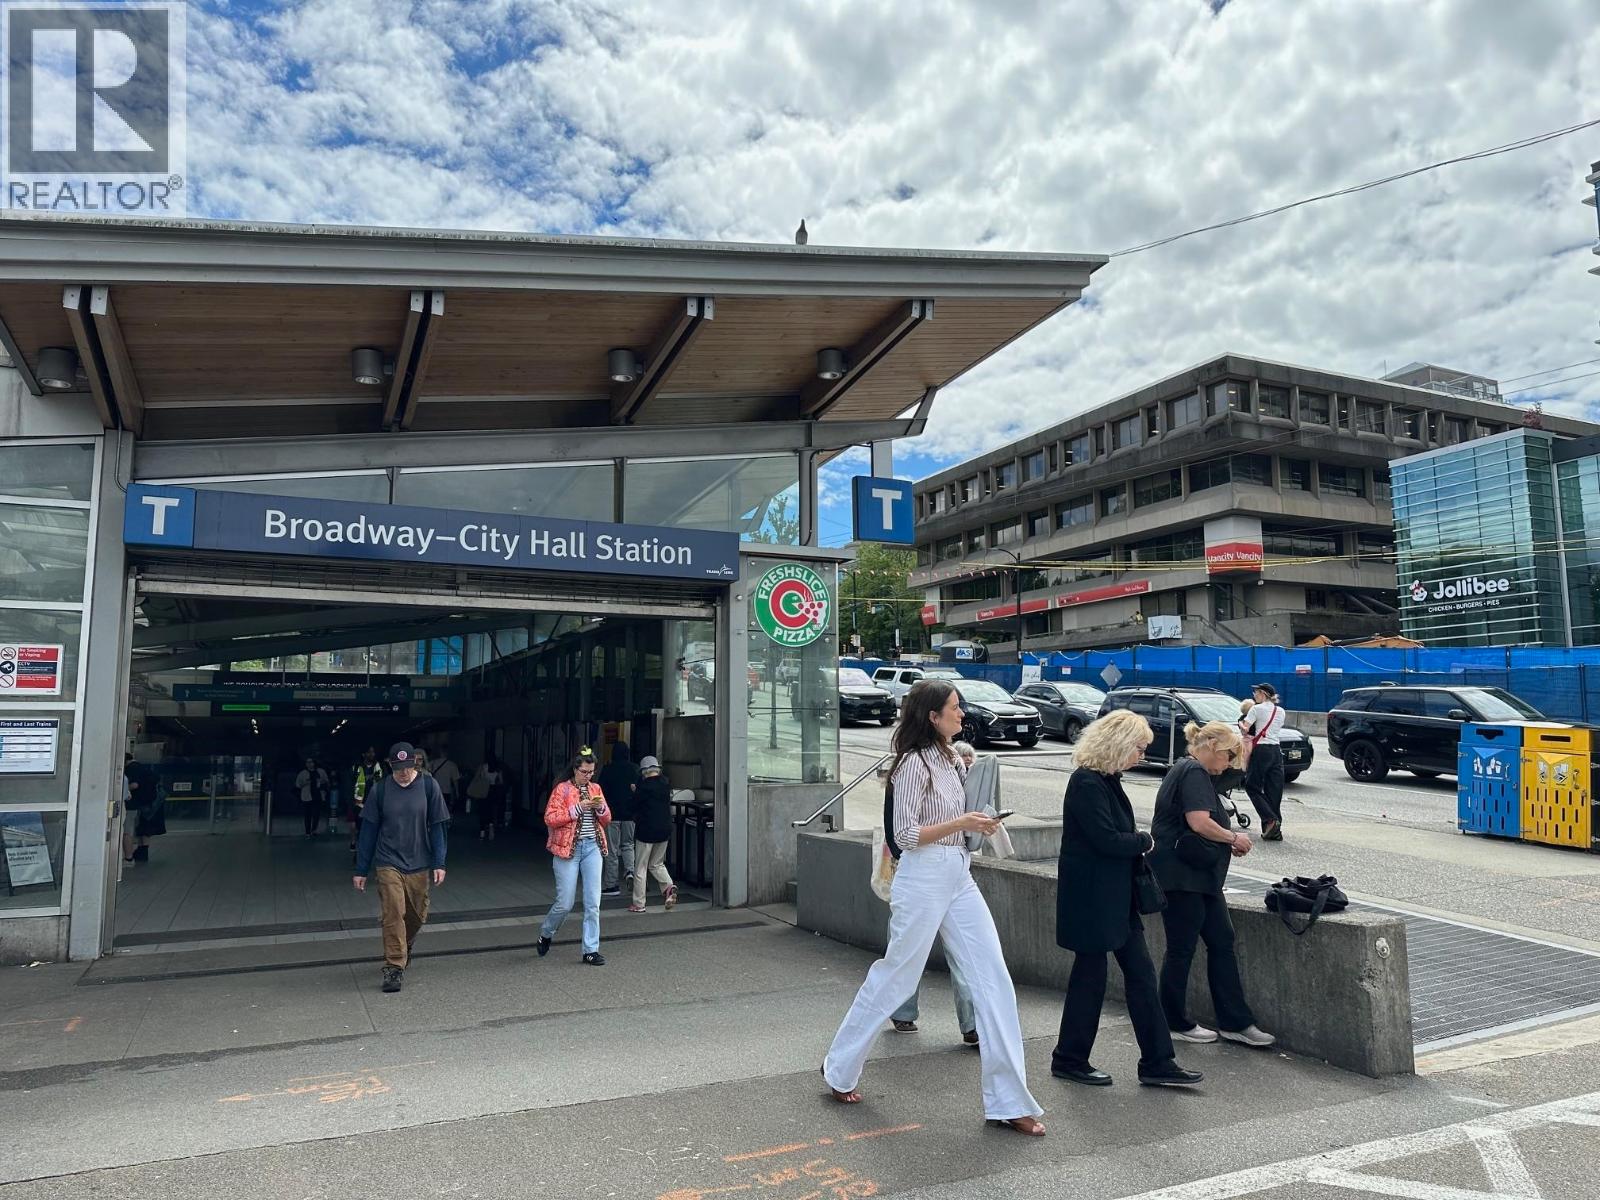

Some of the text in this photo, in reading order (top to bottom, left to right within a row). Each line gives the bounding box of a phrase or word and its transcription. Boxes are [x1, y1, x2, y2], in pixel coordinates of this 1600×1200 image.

[141, 495, 180, 536] T
[871, 487, 903, 530] T
[530, 529, 587, 559] Hall
[595, 533, 693, 566] Station
[1207, 551, 1234, 563] Vancity
[1236, 551, 1262, 561] Vancity
[758, 566, 827, 600] FRESHSLICE
[1433, 576, 1510, 600] Jollibee
[1428, 605, 1455, 613] CHICKEN
[1456, 601, 1483, 610] BURGERS
[773, 626, 816, 643] PIZZA
